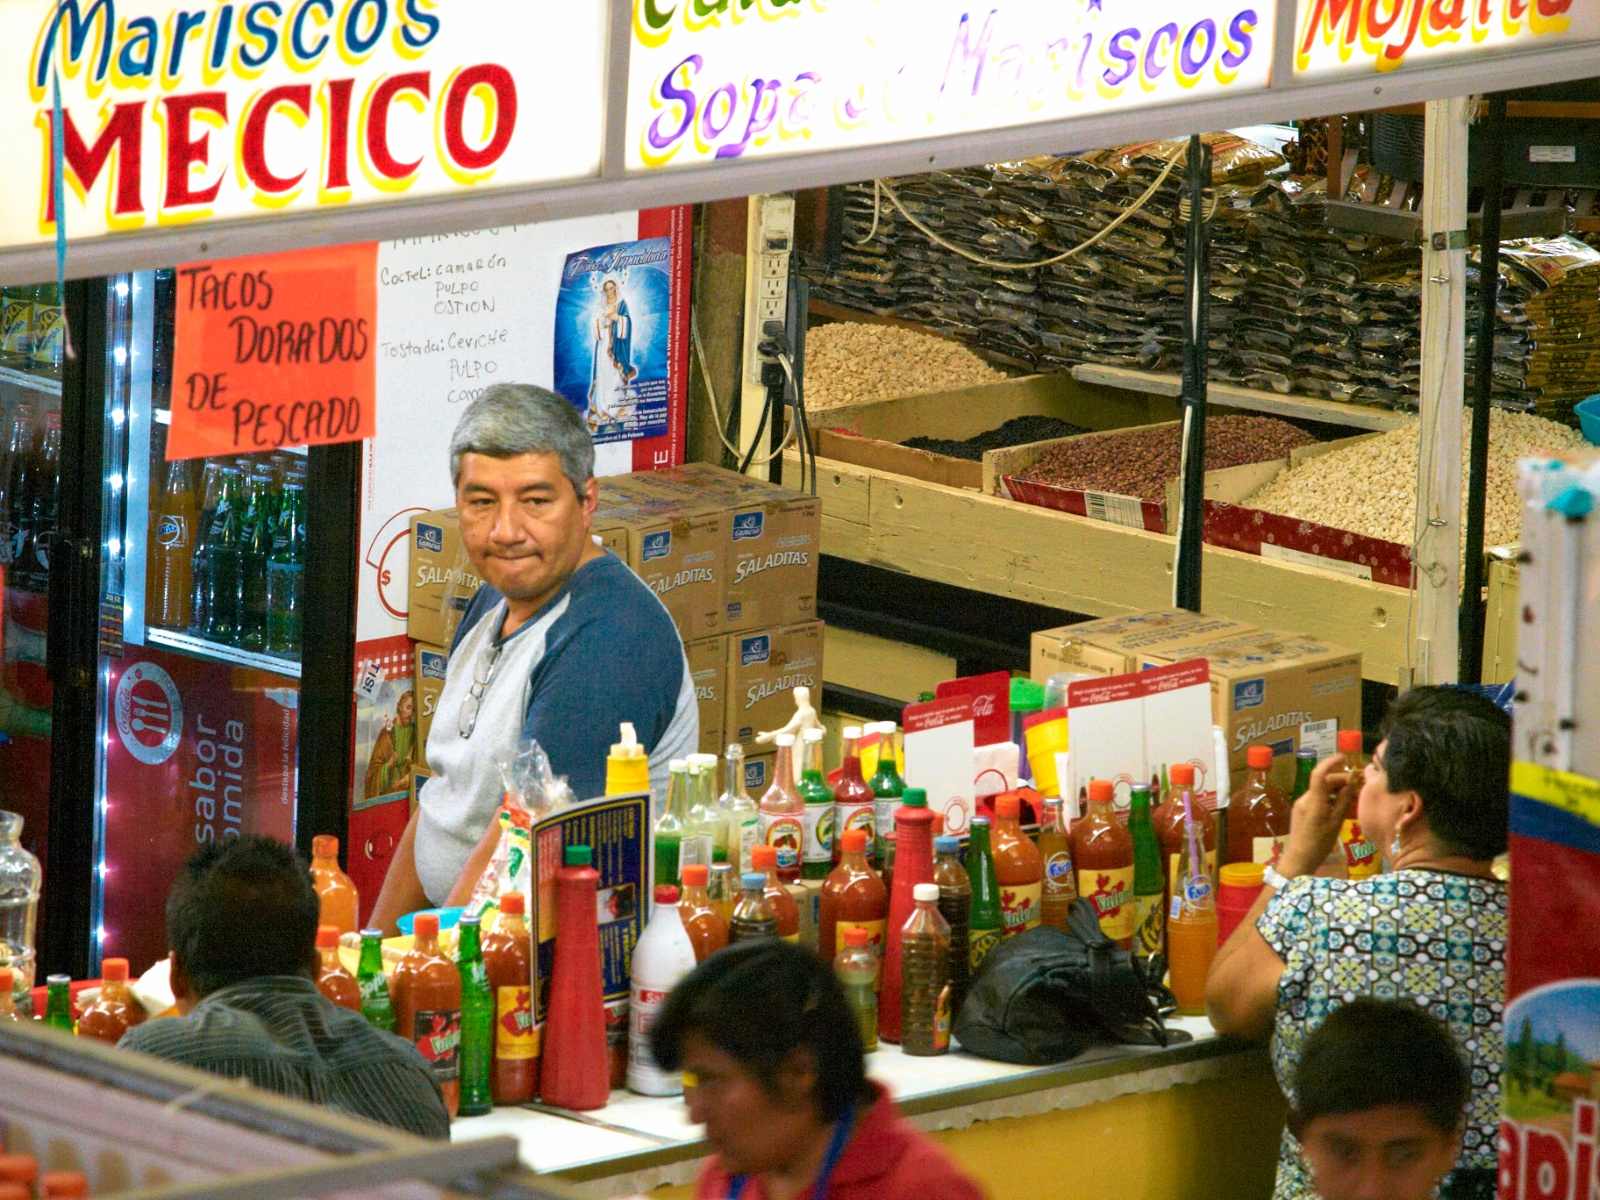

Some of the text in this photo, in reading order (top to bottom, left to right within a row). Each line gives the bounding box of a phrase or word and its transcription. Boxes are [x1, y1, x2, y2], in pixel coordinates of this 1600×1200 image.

[34, 0, 442, 92] Mariscos
[648, 54, 823, 160] Sopa
[45, 63, 518, 223] MECICO
[179, 266, 274, 310] TACOS
[229, 315, 369, 365] DORADOS
[185, 372, 229, 411] DE
[232, 397, 361, 447] PESCADO
[733, 551, 809, 586] SALADITAS
[744, 673, 815, 711] SALADITAS
[1233, 711, 1313, 753] SALADITAS
[188, 713, 217, 847] sabor
[281, 765, 290, 805] destapa
